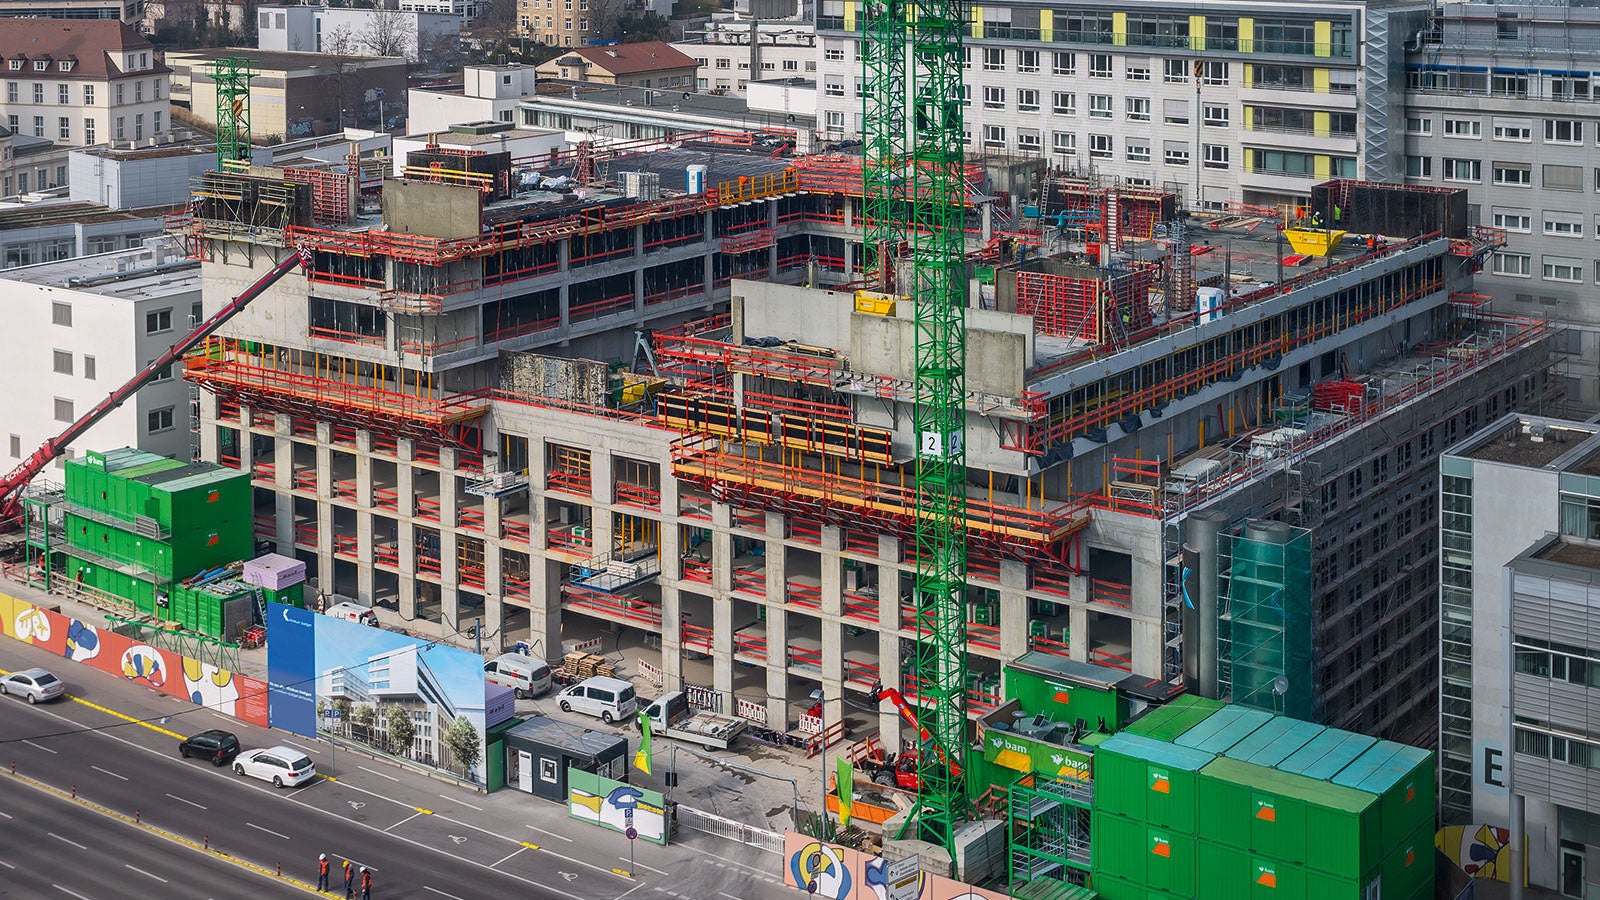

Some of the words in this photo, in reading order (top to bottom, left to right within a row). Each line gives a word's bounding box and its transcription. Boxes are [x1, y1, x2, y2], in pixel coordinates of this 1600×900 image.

[928, 436, 935, 451] 2
[1005, 740, 1026, 754] bam
[1065, 756, 1087, 770] bam
[1484, 747, 1504, 788] E
